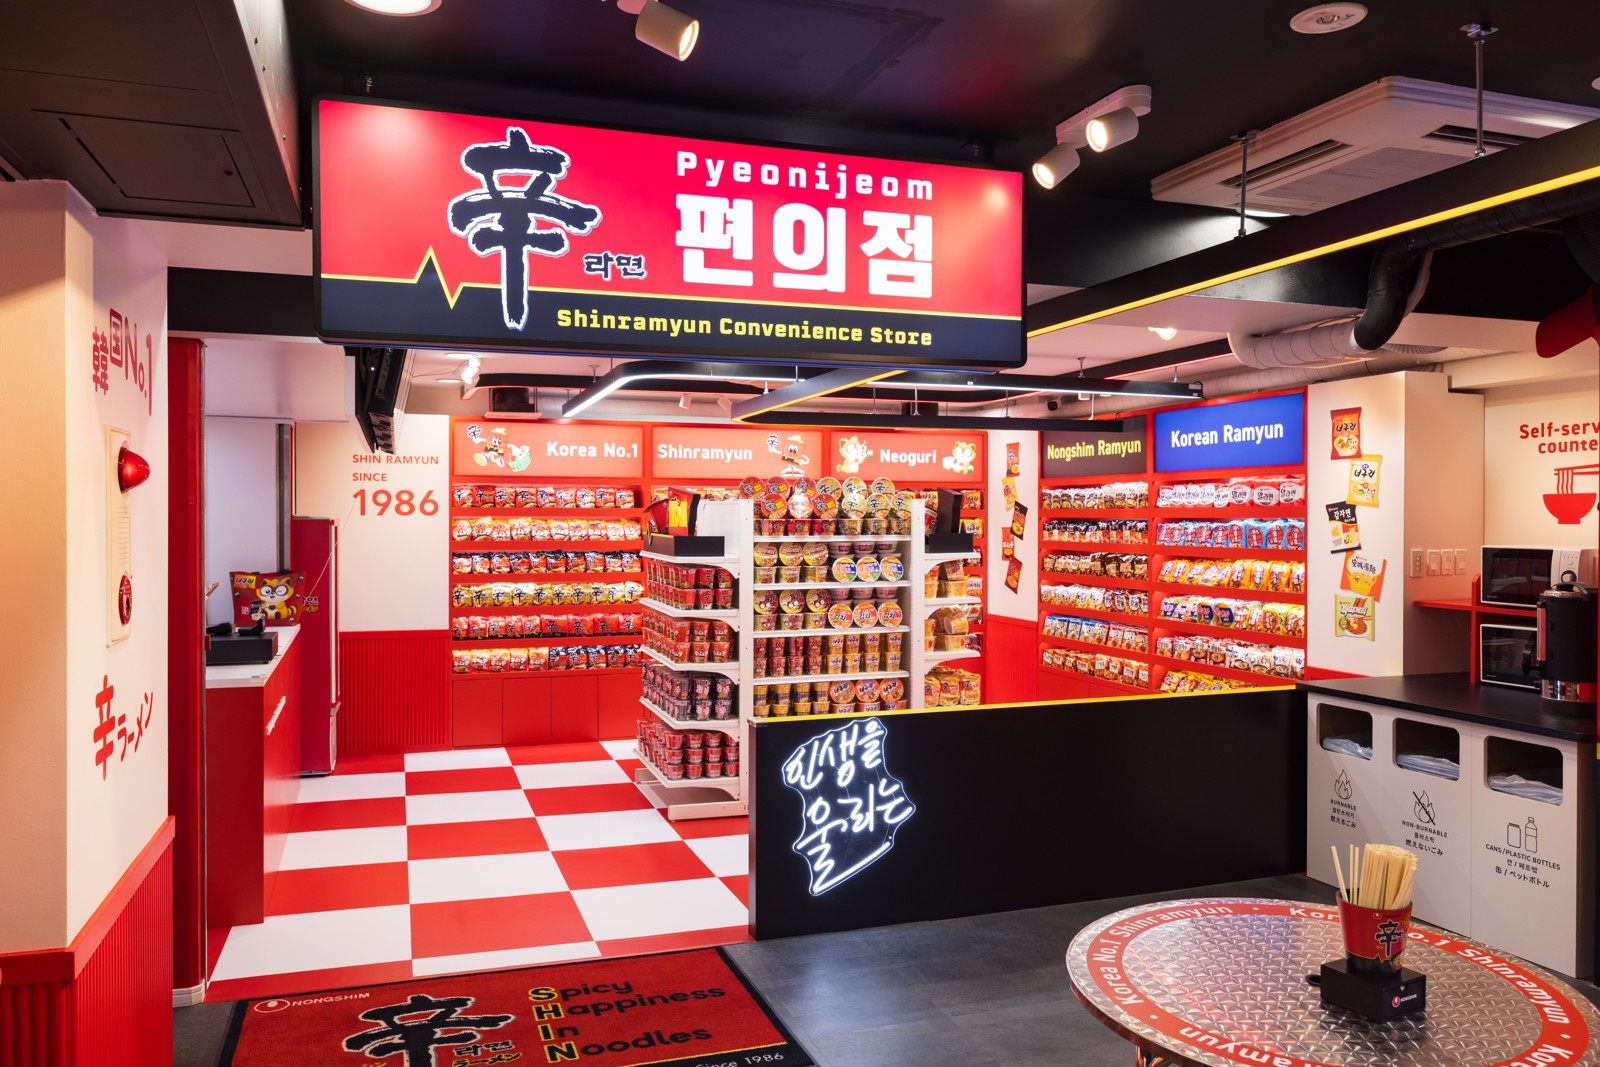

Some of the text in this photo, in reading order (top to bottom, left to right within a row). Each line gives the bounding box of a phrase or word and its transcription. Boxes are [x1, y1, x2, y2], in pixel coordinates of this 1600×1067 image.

[677, 151, 934, 200] Pyeonijeom
[447, 126, 602, 331] 辛
[676, 193, 934, 299] 편의점
[583, 252, 647, 281] 라면
[557, 309, 933, 347] Shinramyun Convenience Store
[1171, 423, 1284, 448] Korean Ramyun
[1336, 422, 1356, 432] 너구리
[546, 441, 638, 458] Korea No.1
[657, 444, 753, 463] Shinramyun
[1047, 438, 1142, 462] Nongshim Ramyun
[1538, 439, 1598, 454] counte
[352, 454, 439, 465] SHIN RAMYUN
[880, 448, 937, 466] Neoguri
[352, 472, 388, 482] SINCE
[1354, 469, 1375, 478] 너구리
[352, 489, 439, 516] 1986
[93, 674, 153, 781] 辛ラーメン
[786, 720, 884, 790] 인생을
[1330, 798, 1357, 811] BURNABLE
[797, 778, 912, 893] 울리는
[1401, 820, 1447, 838] NON-BURNABLE
[1405, 839, 1443, 856] 燃えないごみ
[1532, 857, 1561, 870] BOTTLES
[1509, 870, 1550, 888] ペットボトル
[1375, 920, 1403, 958] 辛
[1093, 905, 1233, 1005] Korea No.1 Shinramyun
[1289, 907, 1571, 1024] Kor o.1 Shinramyun
[292, 992, 370, 1007] NONGSHIM
[529, 981, 634, 1001] Spicy
[532, 987, 726, 1021] Happiness
[538, 1024, 580, 1041] In
[454, 1040, 515, 1057] 라면
[544, 1027, 713, 1063] Noodles
[1179, 1027, 1326, 1067] amyun
[744, 1052, 785, 1066] 1986
